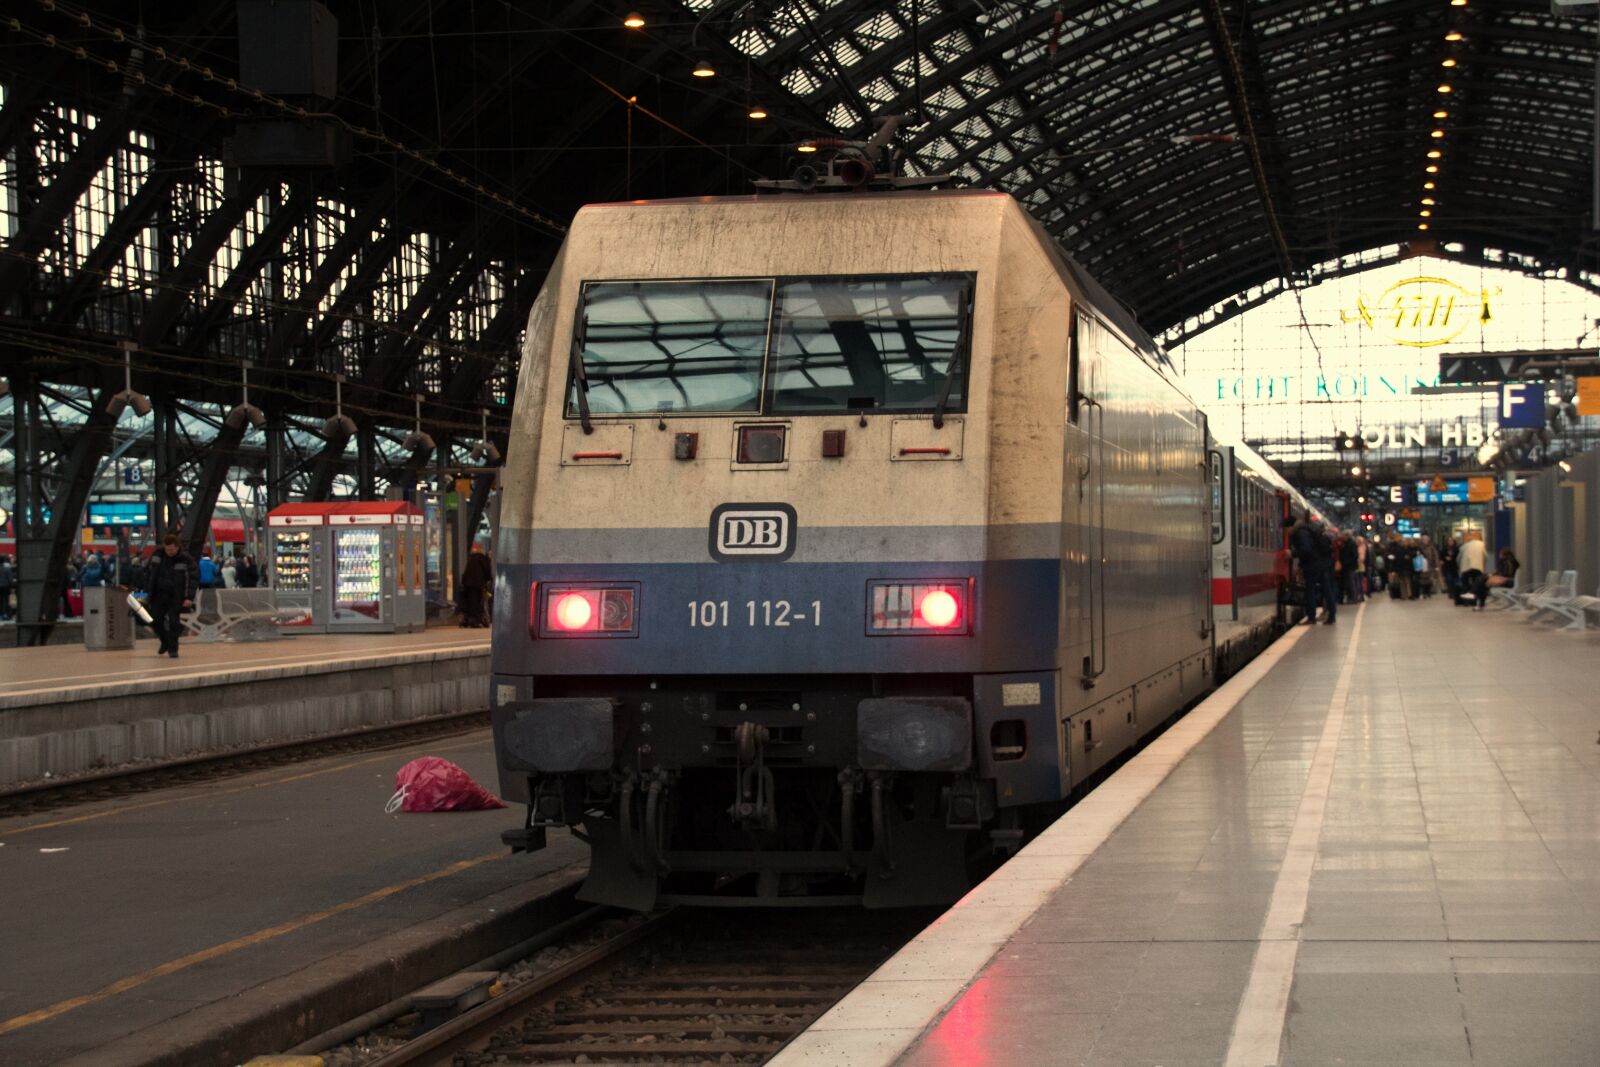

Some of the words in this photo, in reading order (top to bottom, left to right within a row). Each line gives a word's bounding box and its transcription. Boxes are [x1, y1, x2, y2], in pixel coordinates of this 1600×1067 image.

[1217, 376, 1296, 400] ECHT
[1503, 384, 1527, 418] F
[1441, 452, 1453, 465] 5
[1527, 448, 1539, 462] 4
[131, 465, 141, 482] 8
[1390, 486, 1403, 503] E
[1384, 513, 1395, 526] D
[724, 519, 778, 546] DB
[688, 600, 729, 627] 101
[746, 600, 821, 627] 112-1
